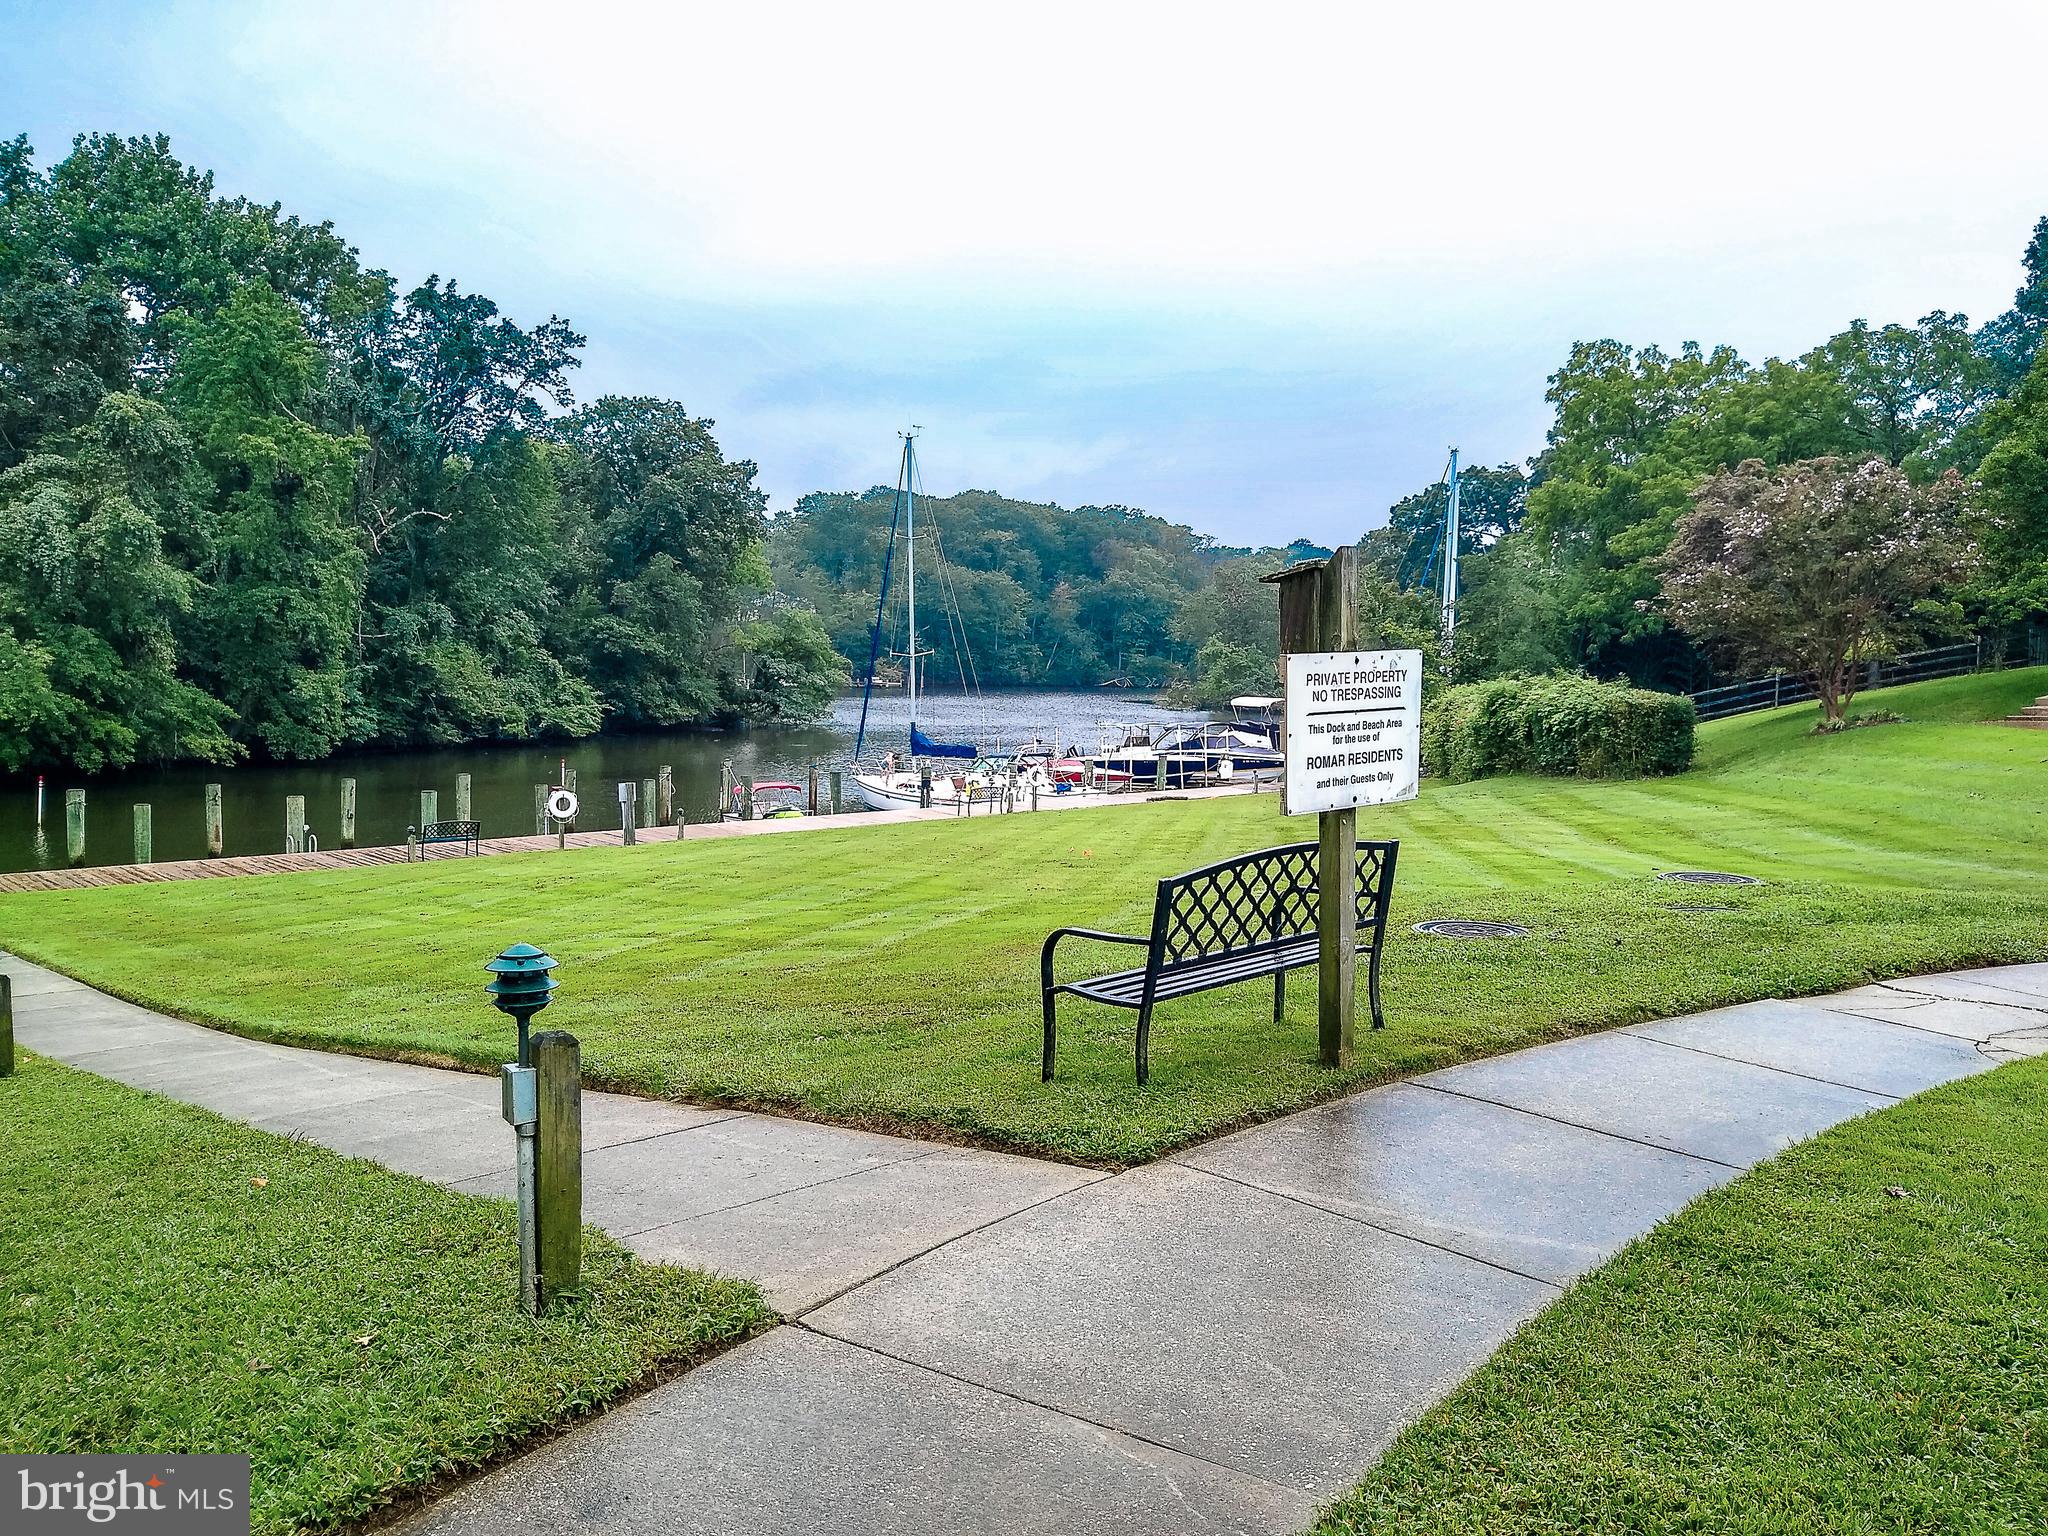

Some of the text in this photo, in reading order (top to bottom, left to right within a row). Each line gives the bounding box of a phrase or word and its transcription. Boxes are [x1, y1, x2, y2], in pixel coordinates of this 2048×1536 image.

[1306, 670, 1408, 686] PRIVATE PROPERTY
[1312, 686, 1401, 702] NO TRESPASSING
[1308, 719, 1402, 734] This Dock and Beach Area
[1332, 734, 1343, 744] for
[1344, 734, 1356, 744] the
[1372, 732, 1380, 741] of
[1306, 748, 1403, 770] ROMAR RESIDENTS
[1316, 772, 1394, 788] and their Guests Only
